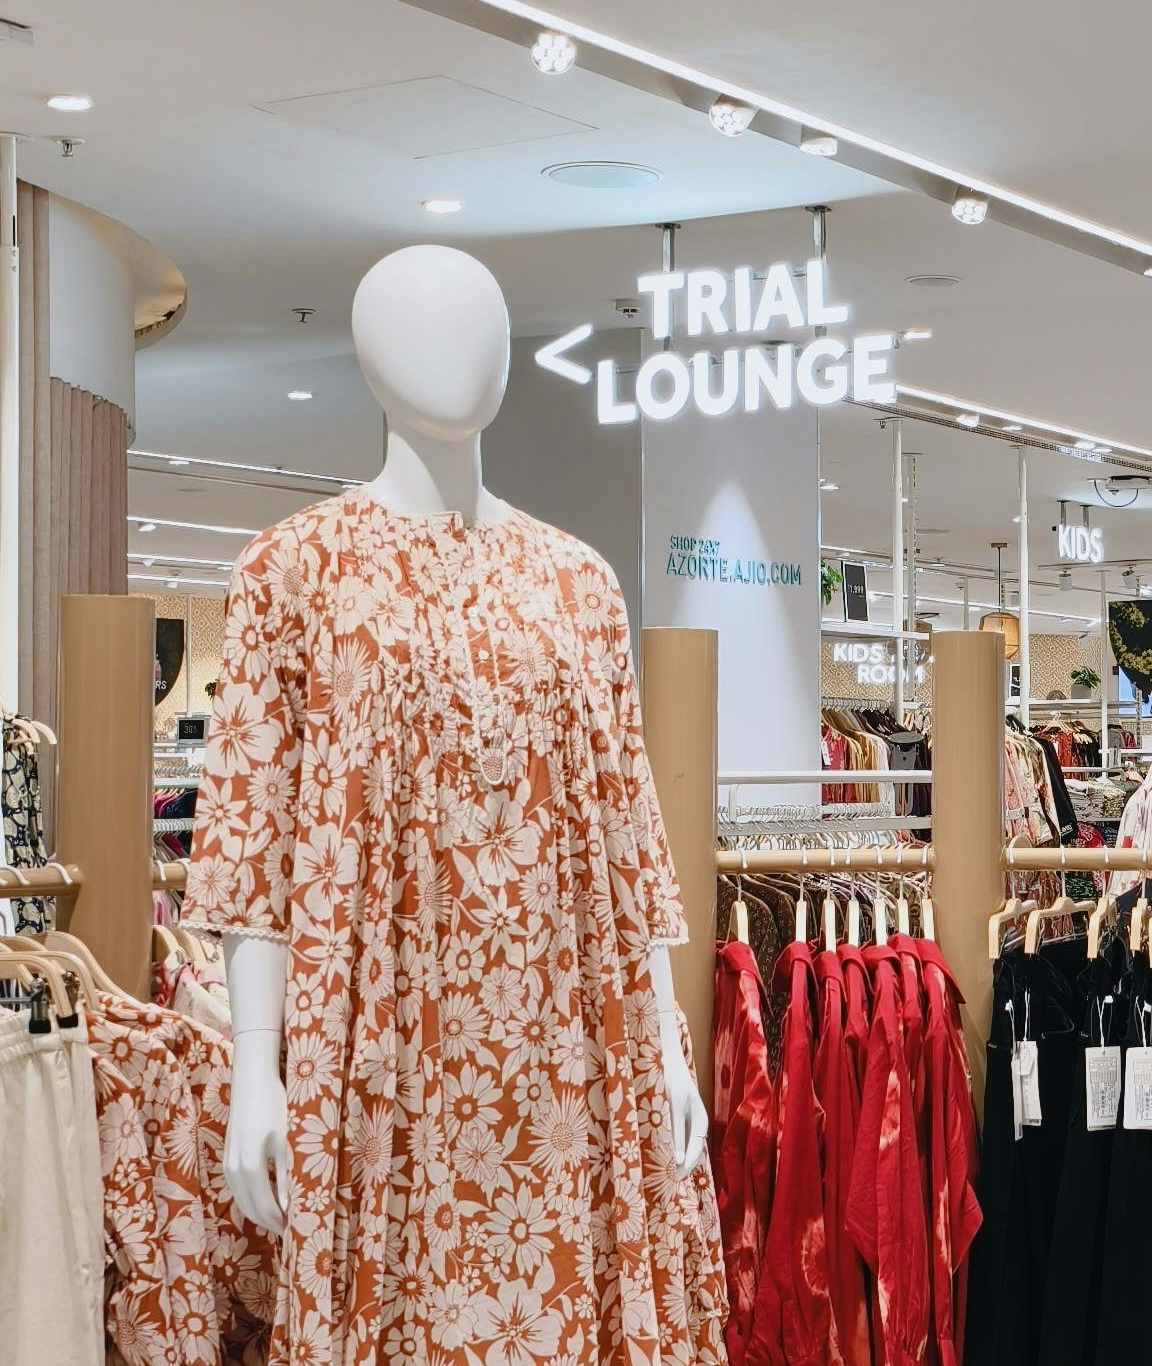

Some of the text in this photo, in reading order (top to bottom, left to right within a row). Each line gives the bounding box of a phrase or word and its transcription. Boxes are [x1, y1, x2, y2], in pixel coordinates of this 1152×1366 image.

[637, 259, 848, 338] TRIAL
[597, 335, 897, 424] LOUNGE
[670, 535, 697, 551] SHOP
[1058, 524, 1104, 563] KIDS
[666, 552, 802, 586] AZORTE.AJIO.COM
[833, 643, 883, 663] KIDS
